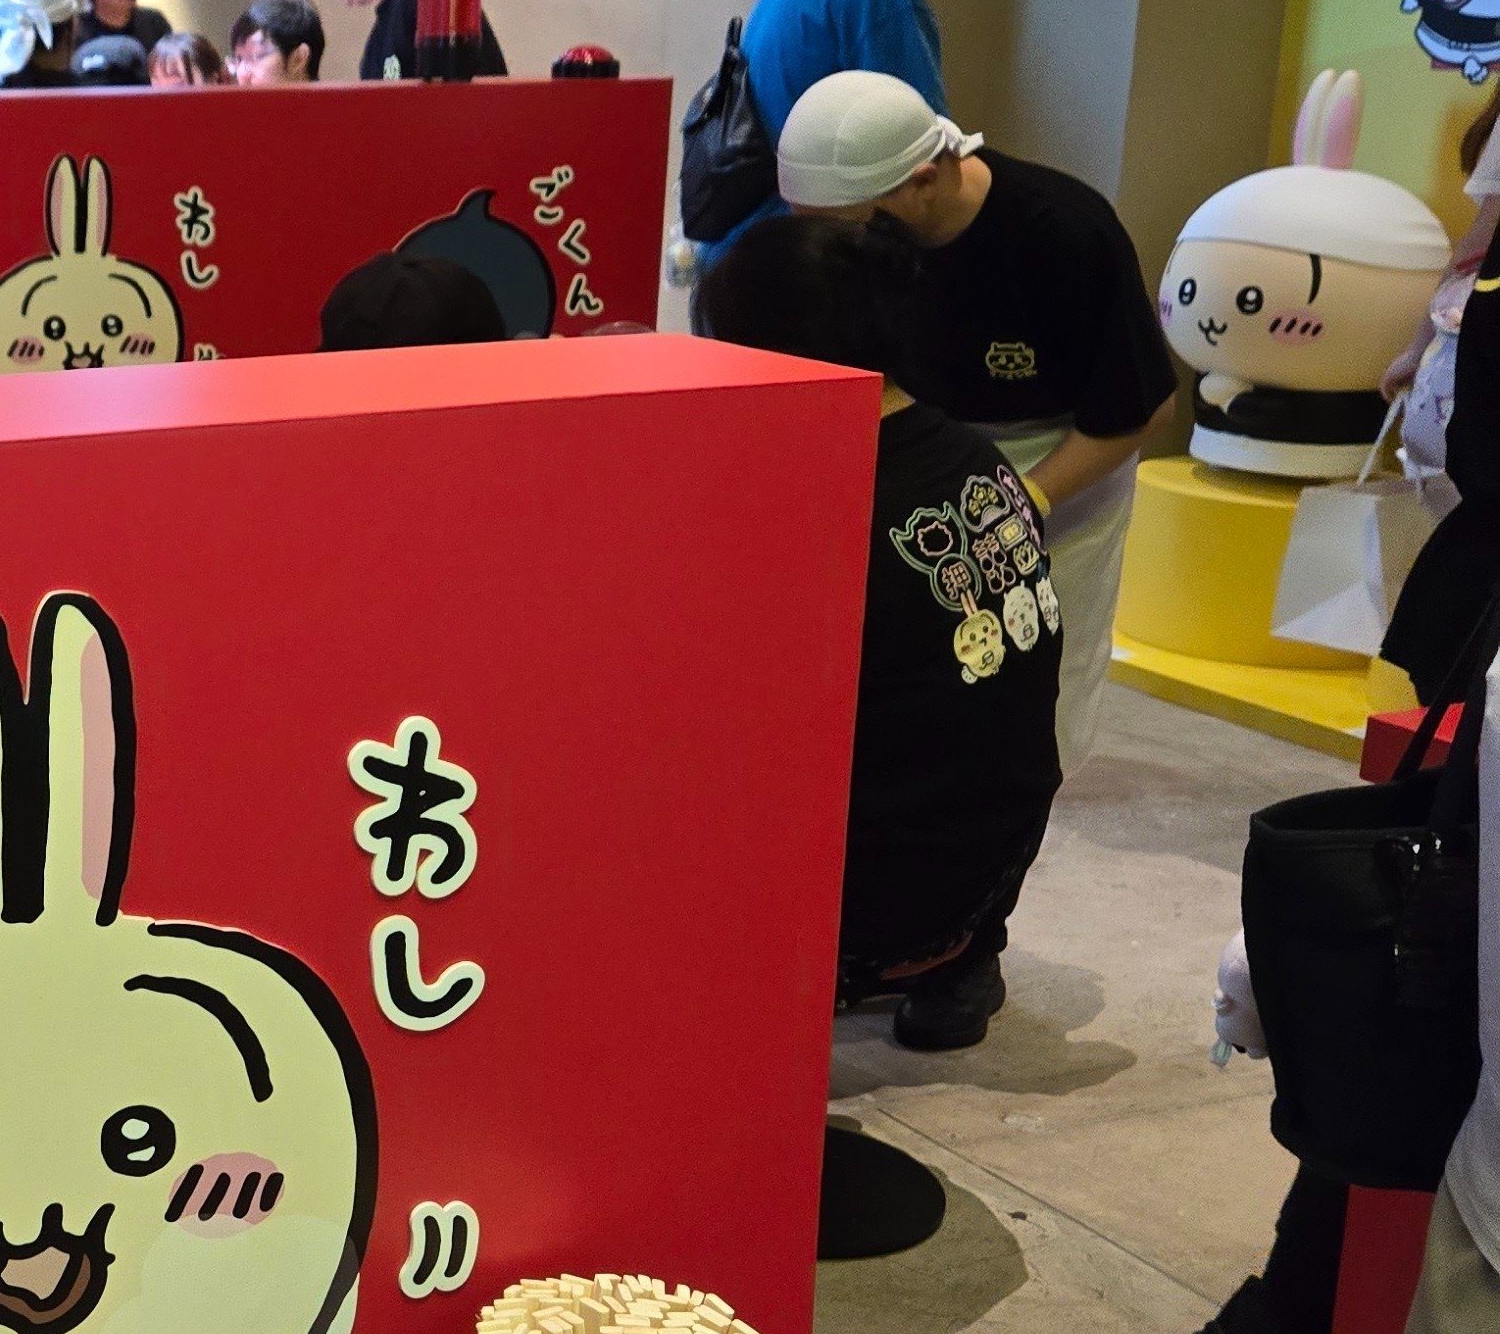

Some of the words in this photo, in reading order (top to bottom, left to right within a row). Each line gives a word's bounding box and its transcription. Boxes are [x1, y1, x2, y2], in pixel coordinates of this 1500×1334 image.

[177, 191, 217, 284] わし
[534, 169, 598, 311] ごくん
[363, 729, 475, 1019] わし
